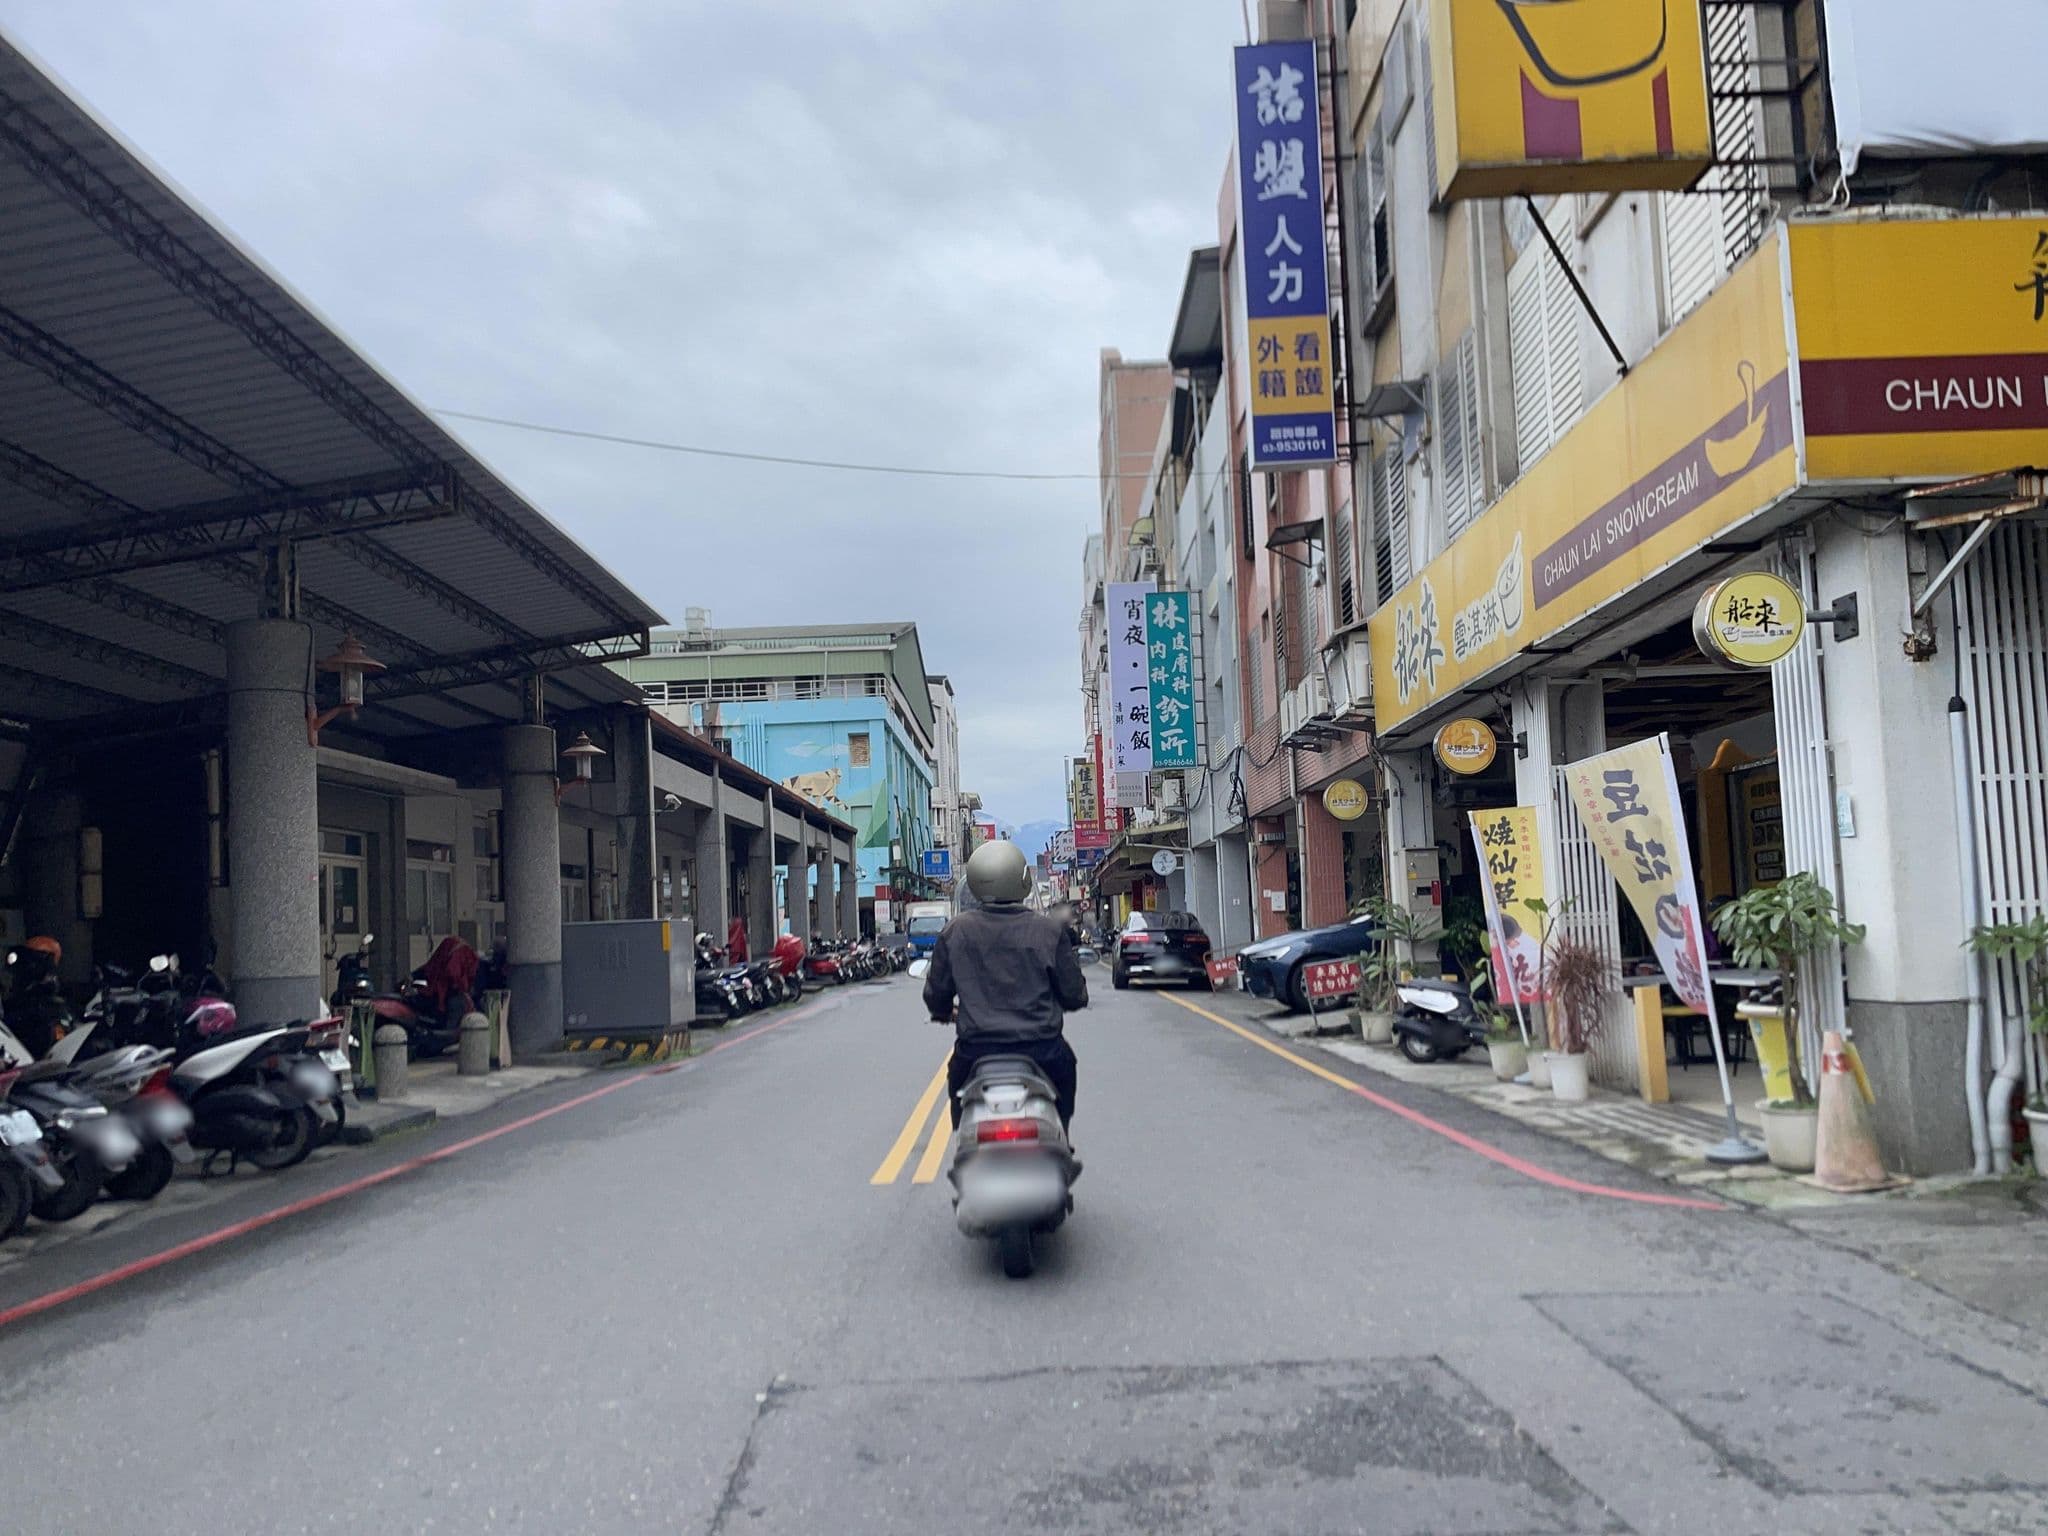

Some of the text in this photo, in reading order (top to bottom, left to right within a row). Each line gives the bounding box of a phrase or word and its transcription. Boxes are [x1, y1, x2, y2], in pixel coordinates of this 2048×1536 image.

[1885, 376, 2022, 411] CHAUN
[1262, 440, 1326, 453] 03-9530101
[1544, 461, 1699, 586] CHAUN LAI SNOWCREAM
[1152, 598, 1185, 630] 林
[1455, 595, 1499, 658] 雪淇淋
[1723, 595, 1781, 633] 船來
[1172, 632, 1190, 695] 皮膚科
[1155, 695, 1189, 756] 診所
[1155, 758, 1193, 766] 03-9546646
[1484, 815, 1519, 910] 燒仙草
